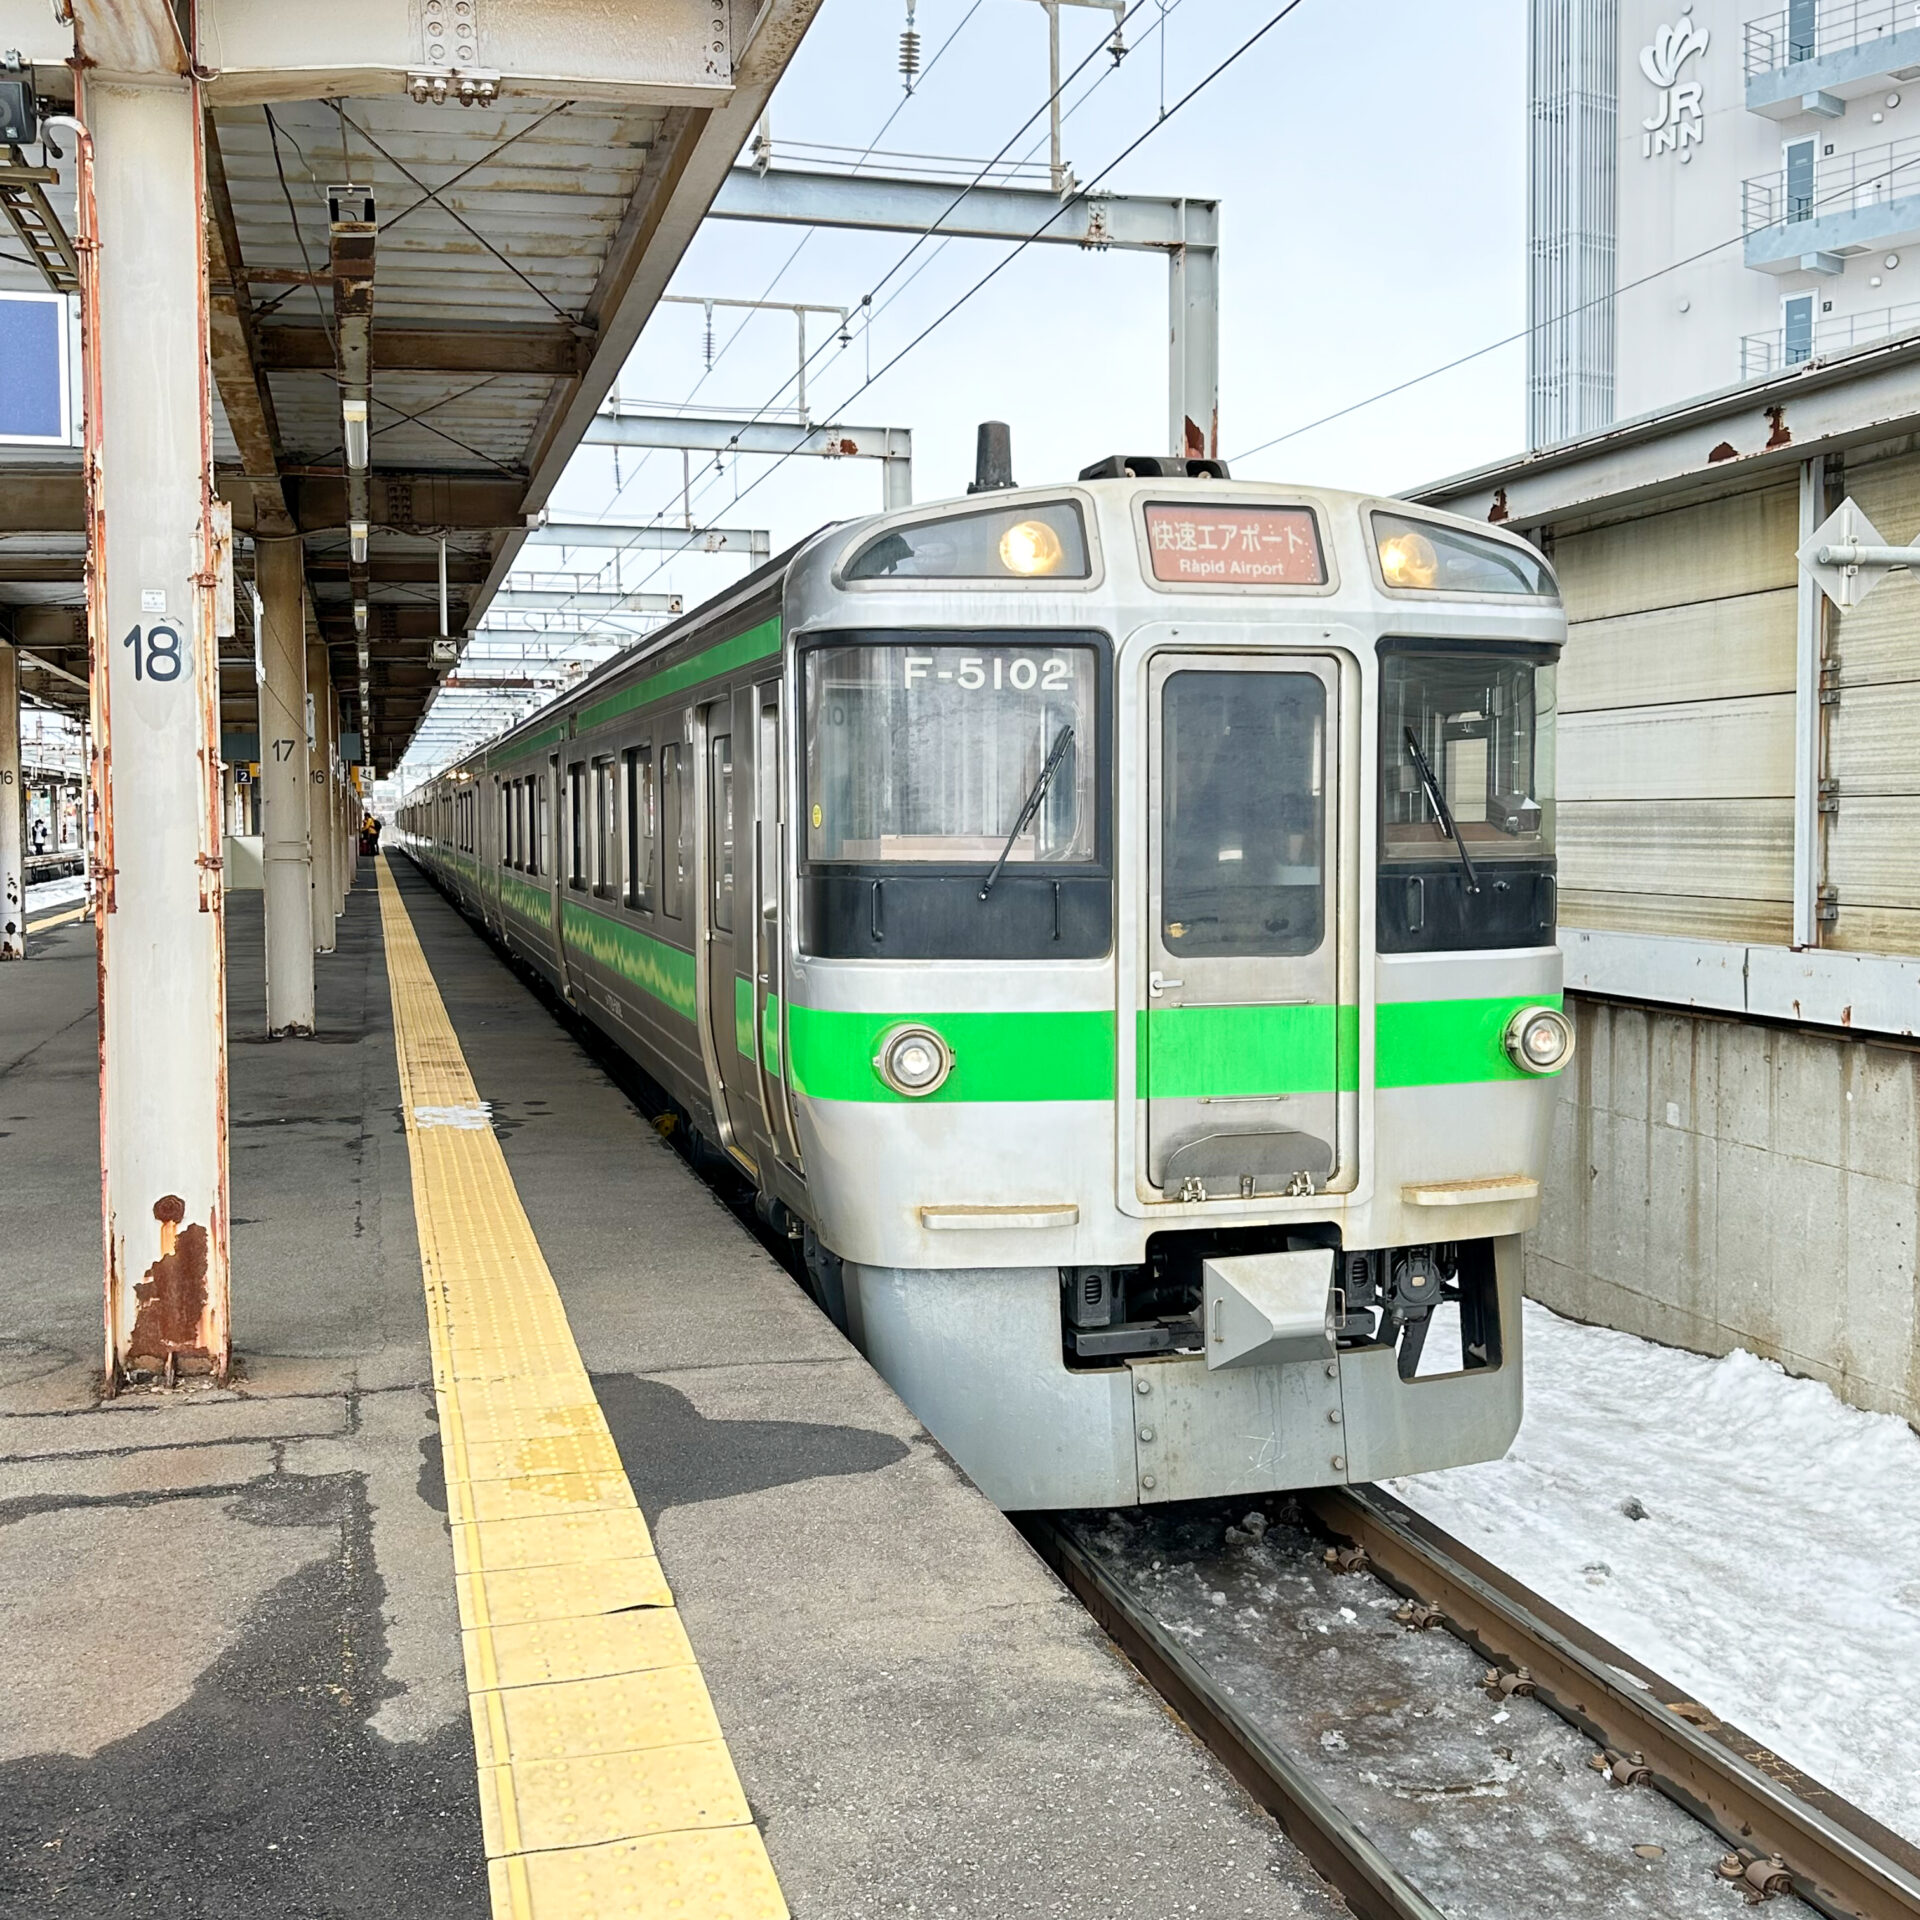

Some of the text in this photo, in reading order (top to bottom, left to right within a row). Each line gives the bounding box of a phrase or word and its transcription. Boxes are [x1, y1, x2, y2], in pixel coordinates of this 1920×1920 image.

[1641, 81, 1703, 131] JR
[1642, 118, 1704, 159] INN
[1152, 519, 1303, 554] 快速エアポート
[1179, 558, 1285, 577] Rapid Airport
[123, 624, 182, 682] 18
[904, 656, 1069, 690] F-5102
[272, 739, 296, 762] 17
[0, 769, 14, 785] 16
[240, 772, 249, 782] 2
[309, 769, 325, 784] 16
